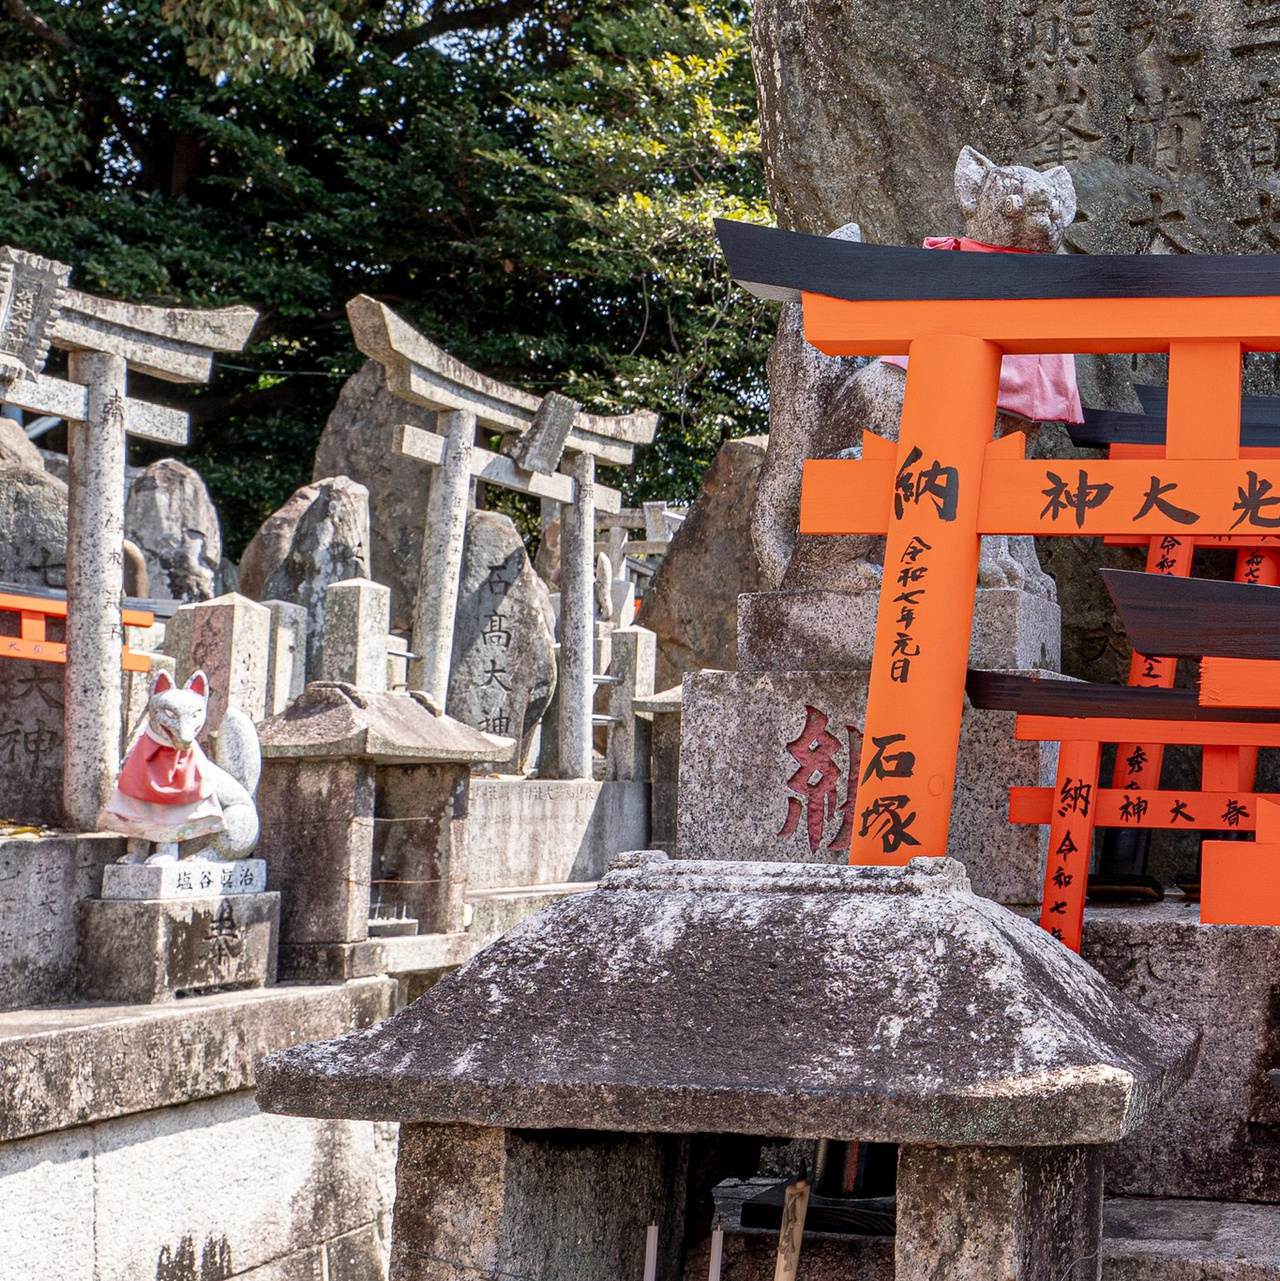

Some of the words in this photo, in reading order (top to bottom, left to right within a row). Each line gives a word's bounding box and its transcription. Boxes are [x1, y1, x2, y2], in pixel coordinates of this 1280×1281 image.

[895, 447, 959, 522] 納
[890, 536, 932, 683] 令和七年元日
[858, 733, 921, 853] 石塚
[1058, 777, 1092, 818] 納
[1050, 830, 1079, 943] 令和七年
